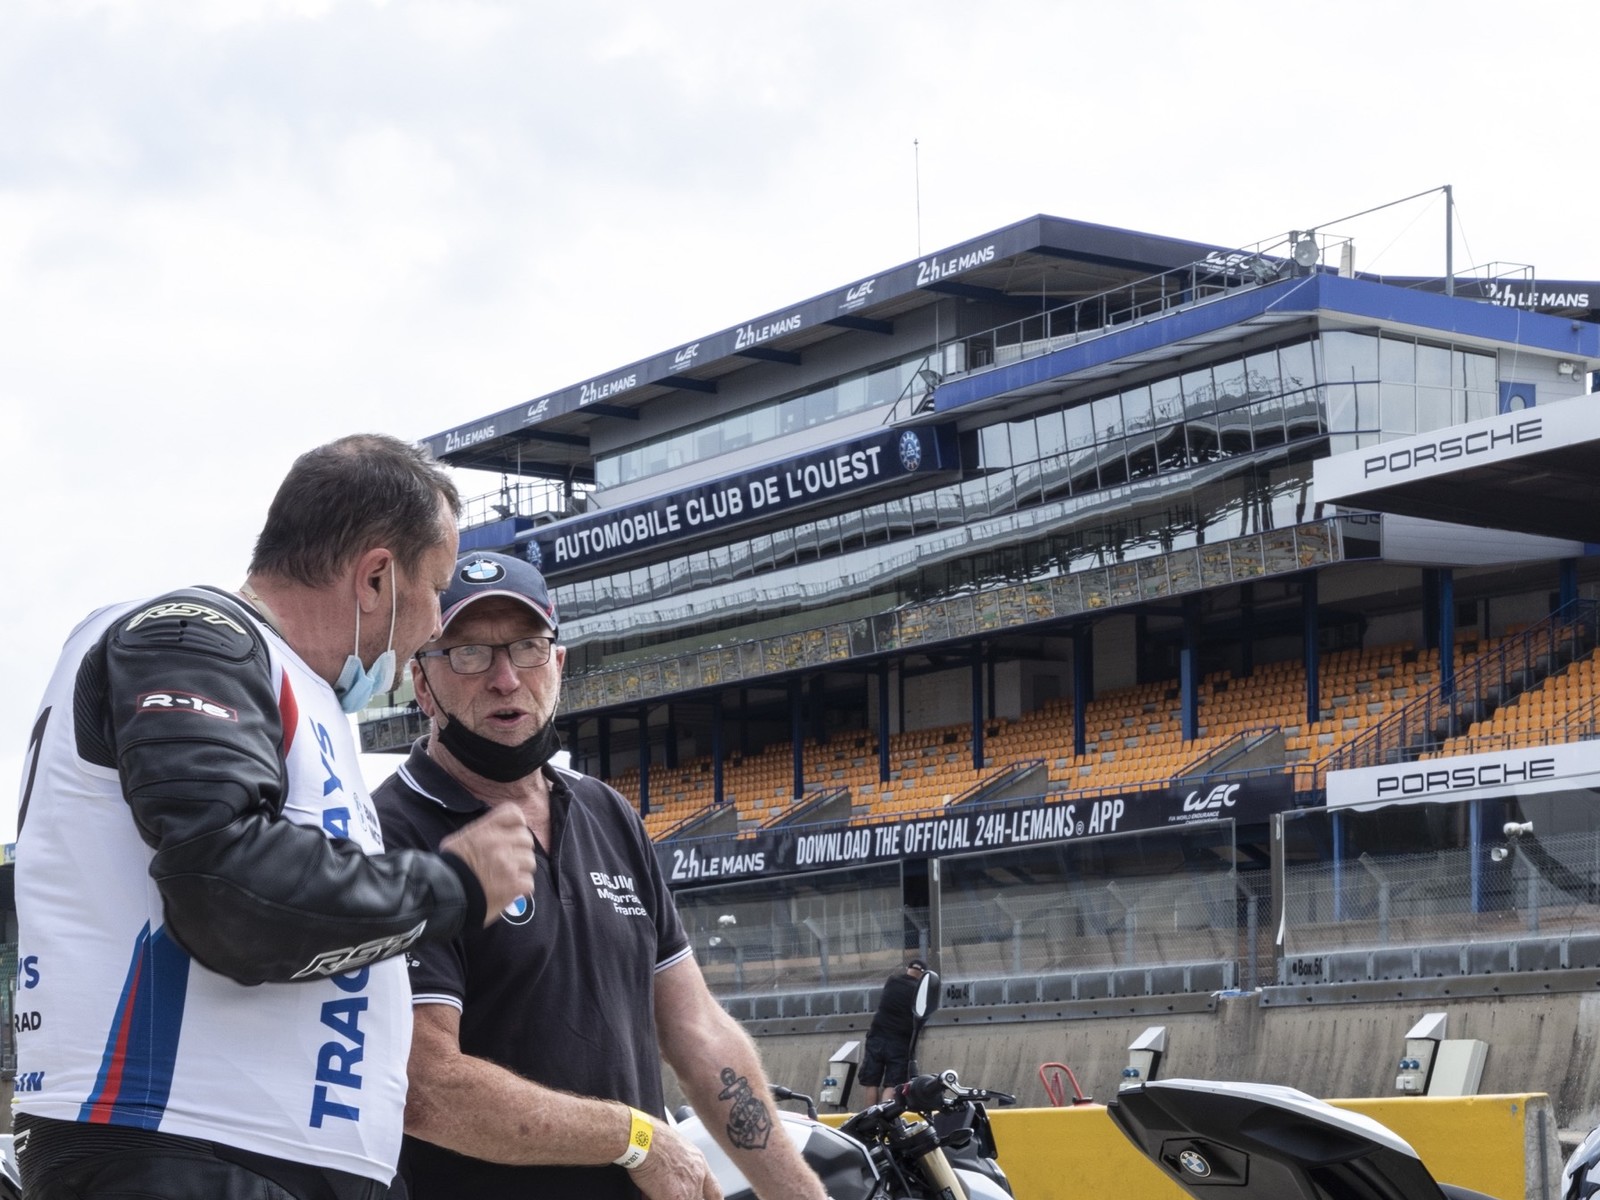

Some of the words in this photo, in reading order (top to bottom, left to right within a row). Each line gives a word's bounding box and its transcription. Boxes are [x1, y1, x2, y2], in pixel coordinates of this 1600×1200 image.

[941, 258, 958, 277] LE
[958, 245, 995, 271] MANS
[846, 279, 875, 301] WEC
[1518, 292, 1539, 306] LE
[1541, 292, 1589, 307] MANS
[755, 326, 770, 342] LE
[770, 314, 801, 337] MANS
[675, 343, 699, 363] WEC
[597, 384, 609, 399] LE
[609, 374, 637, 395] MANS
[527, 399, 549, 417] WEC
[461, 433, 472, 447] LE
[471, 425, 495, 442] MANS
[1364, 418, 1543, 479] PORSCHE
[555, 504, 681, 563] AUTOMOBILE
[685, 487, 743, 526] CLUB
[749, 476, 781, 509] DE
[786, 446, 881, 499] L'OUEST
[125, 602, 247, 635] RST
[309, 716, 352, 840] AYS
[1377, 758, 1555, 797] PORSCHE
[1183, 783, 1240, 812] WEC
[796, 829, 871, 865] DOWNLOAD
[875, 825, 901, 856] THE
[904, 817, 970, 853] OFFICIAL
[1088, 799, 1124, 834] APP
[701, 857, 720, 877] LE
[721, 853, 765, 875] MANS
[613, 902, 647, 916] France
[1298, 958, 1313, 976] Box
[309, 964, 371, 1129] TRAC
